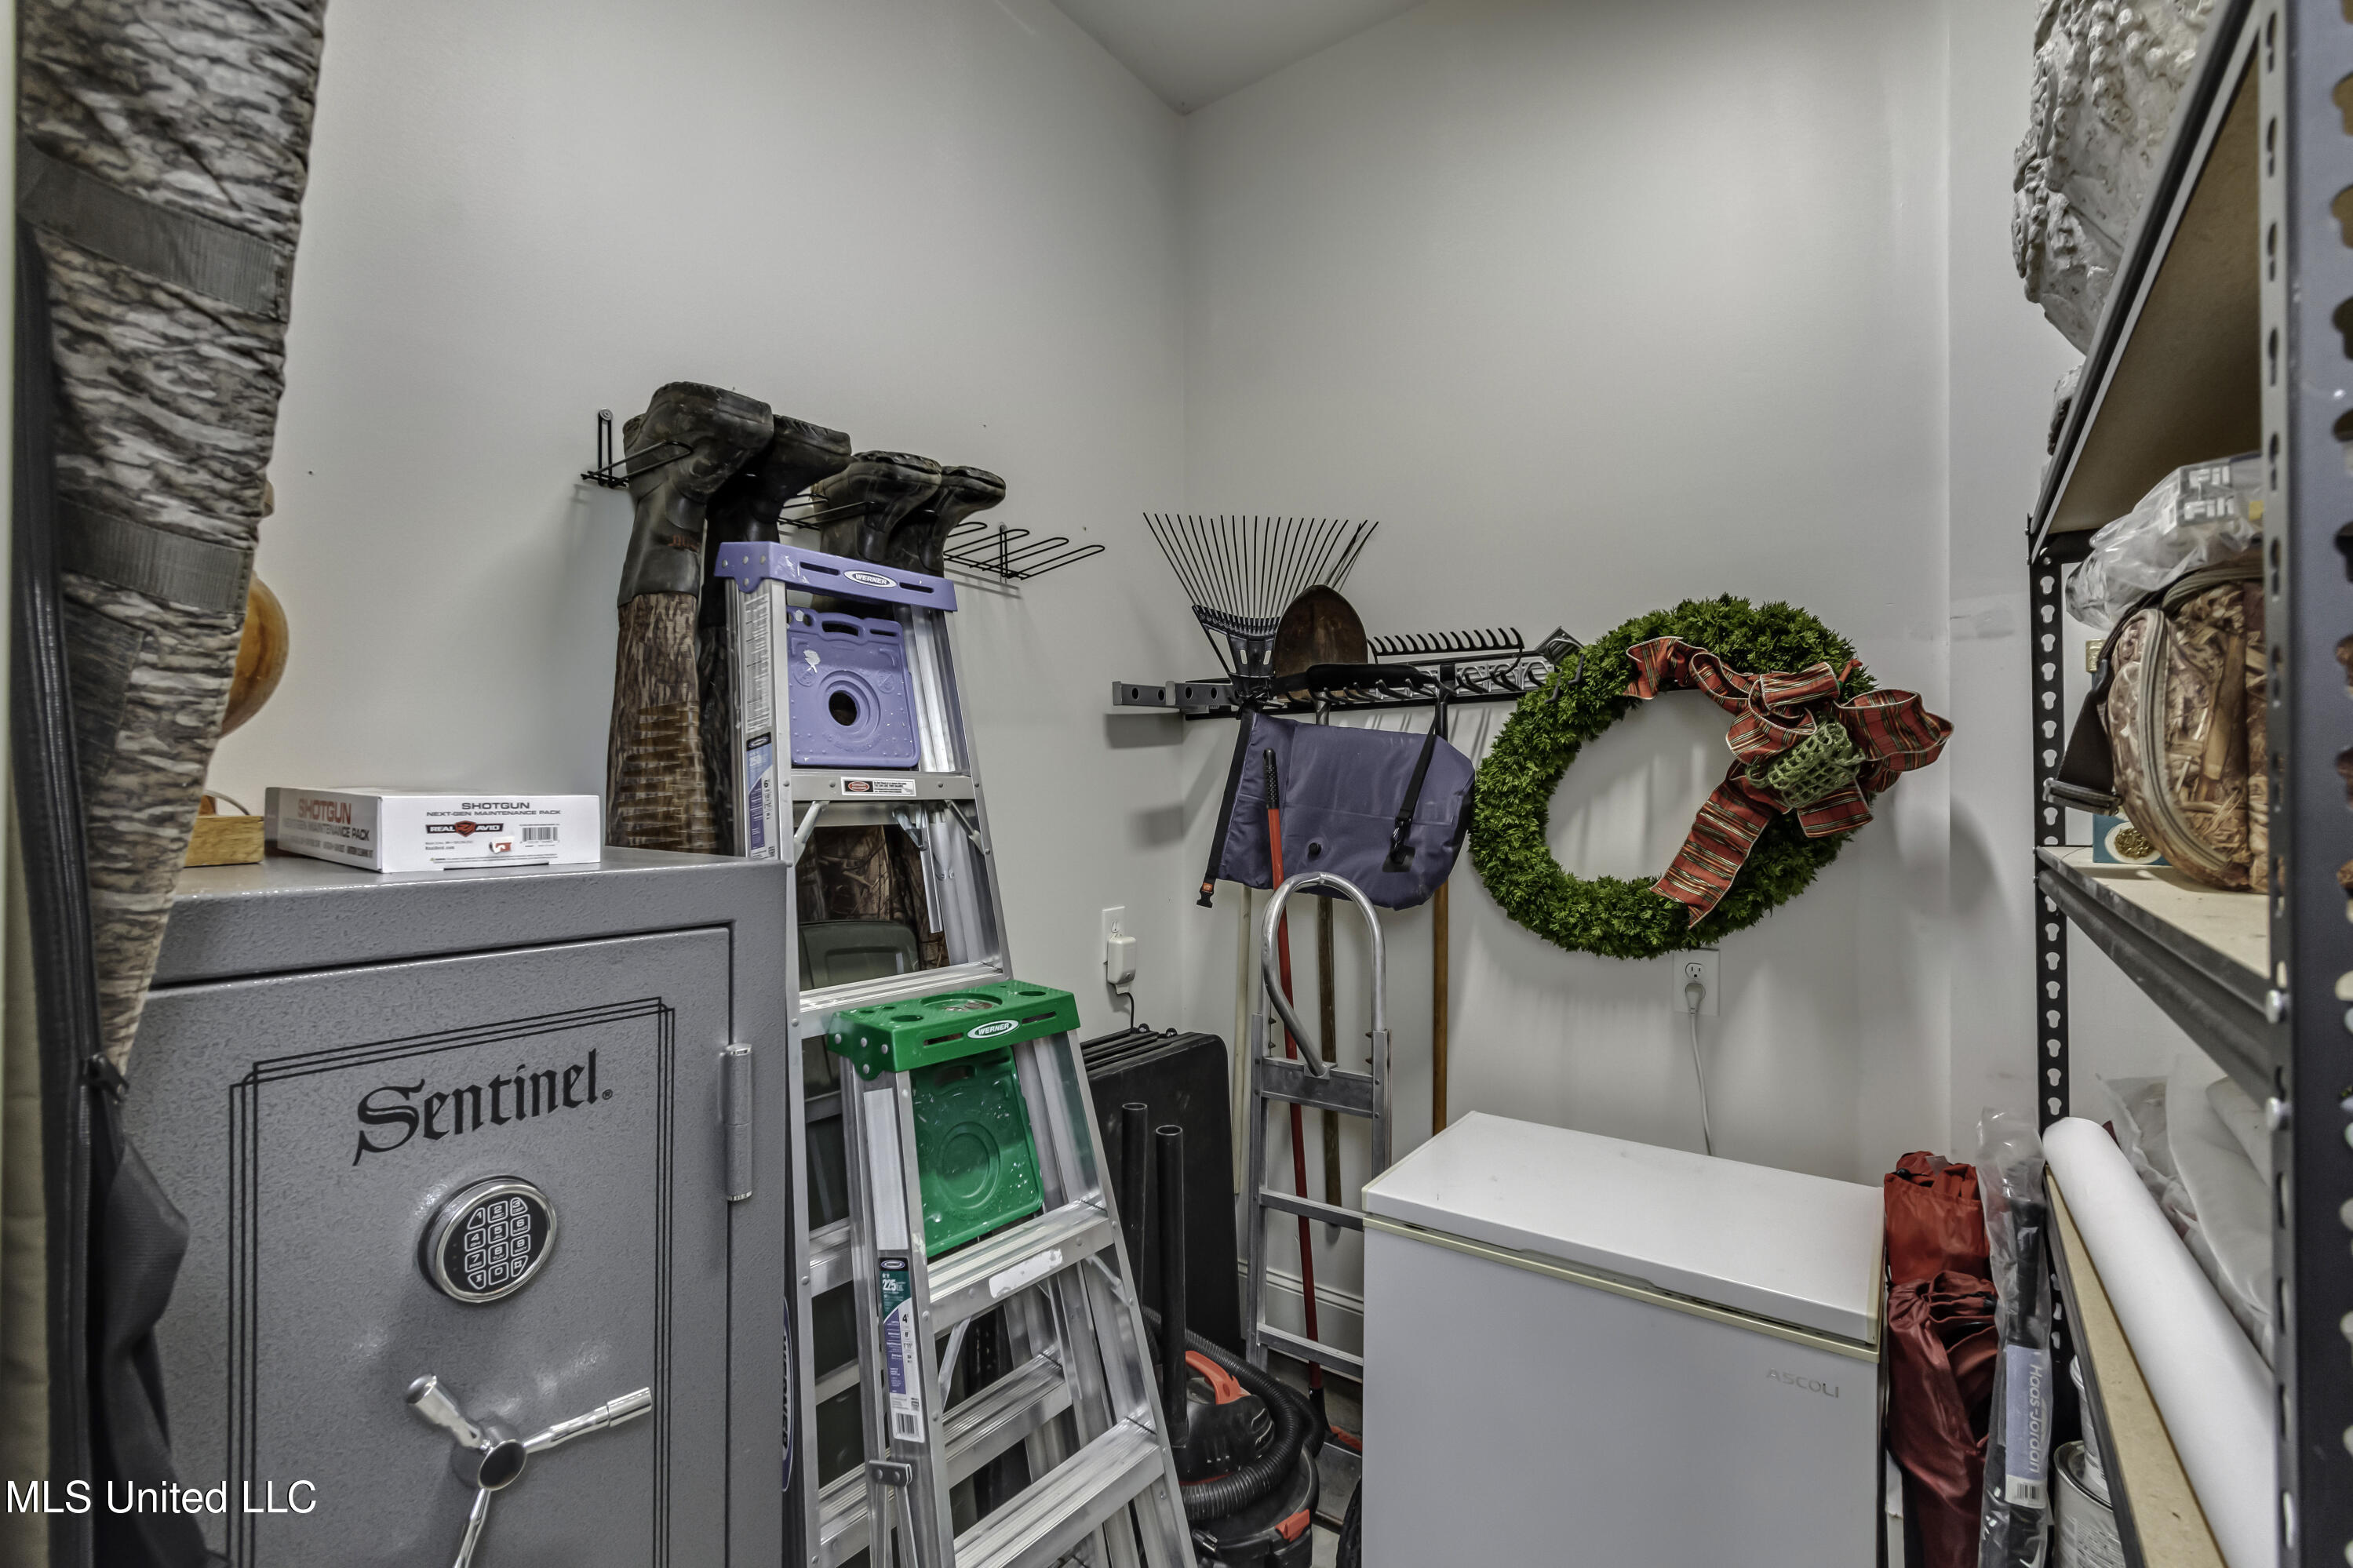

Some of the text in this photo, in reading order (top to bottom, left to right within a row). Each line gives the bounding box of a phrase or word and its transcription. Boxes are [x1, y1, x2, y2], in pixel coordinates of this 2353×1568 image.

[855, 573, 887, 585] WERNER
[297, 798, 351, 825] SHOTGUN
[351, 828, 370, 842] PACK
[978, 1022, 1010, 1035] WERNER
[882, 1279, 897, 1292] 225
[1765, 1367, 1840, 1399] ASCOLI
[2029, 1363, 2043, 1474] Haas-Jordan
